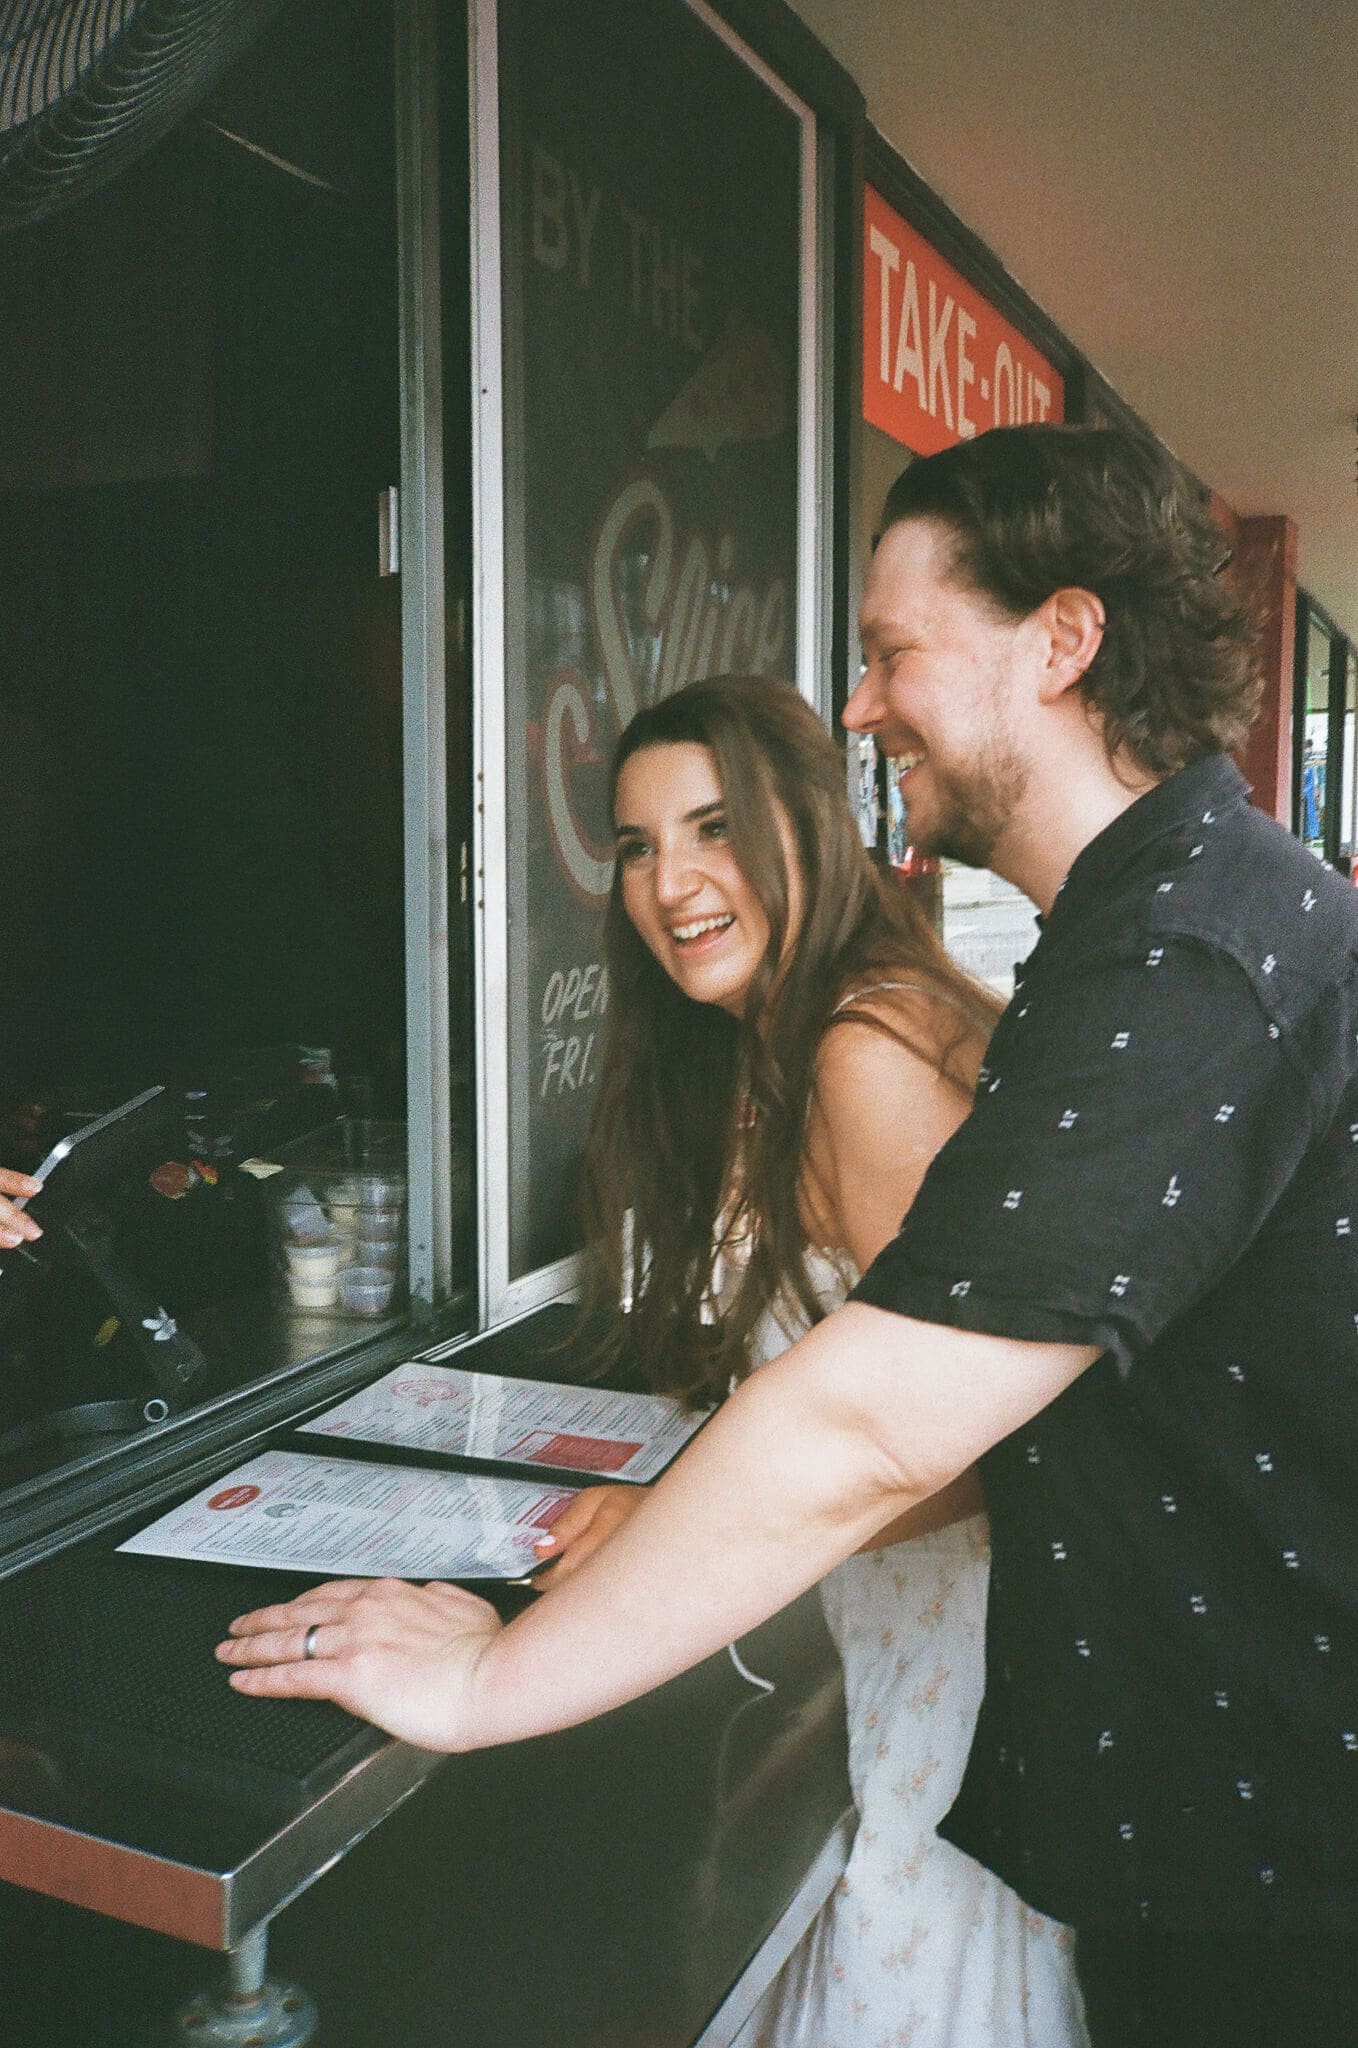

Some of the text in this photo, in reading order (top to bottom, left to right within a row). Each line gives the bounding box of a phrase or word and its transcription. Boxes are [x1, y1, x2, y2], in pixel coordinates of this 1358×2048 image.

[533, 146, 703, 350] BY THE
[870, 224, 1050, 440] TAKE-OUT
